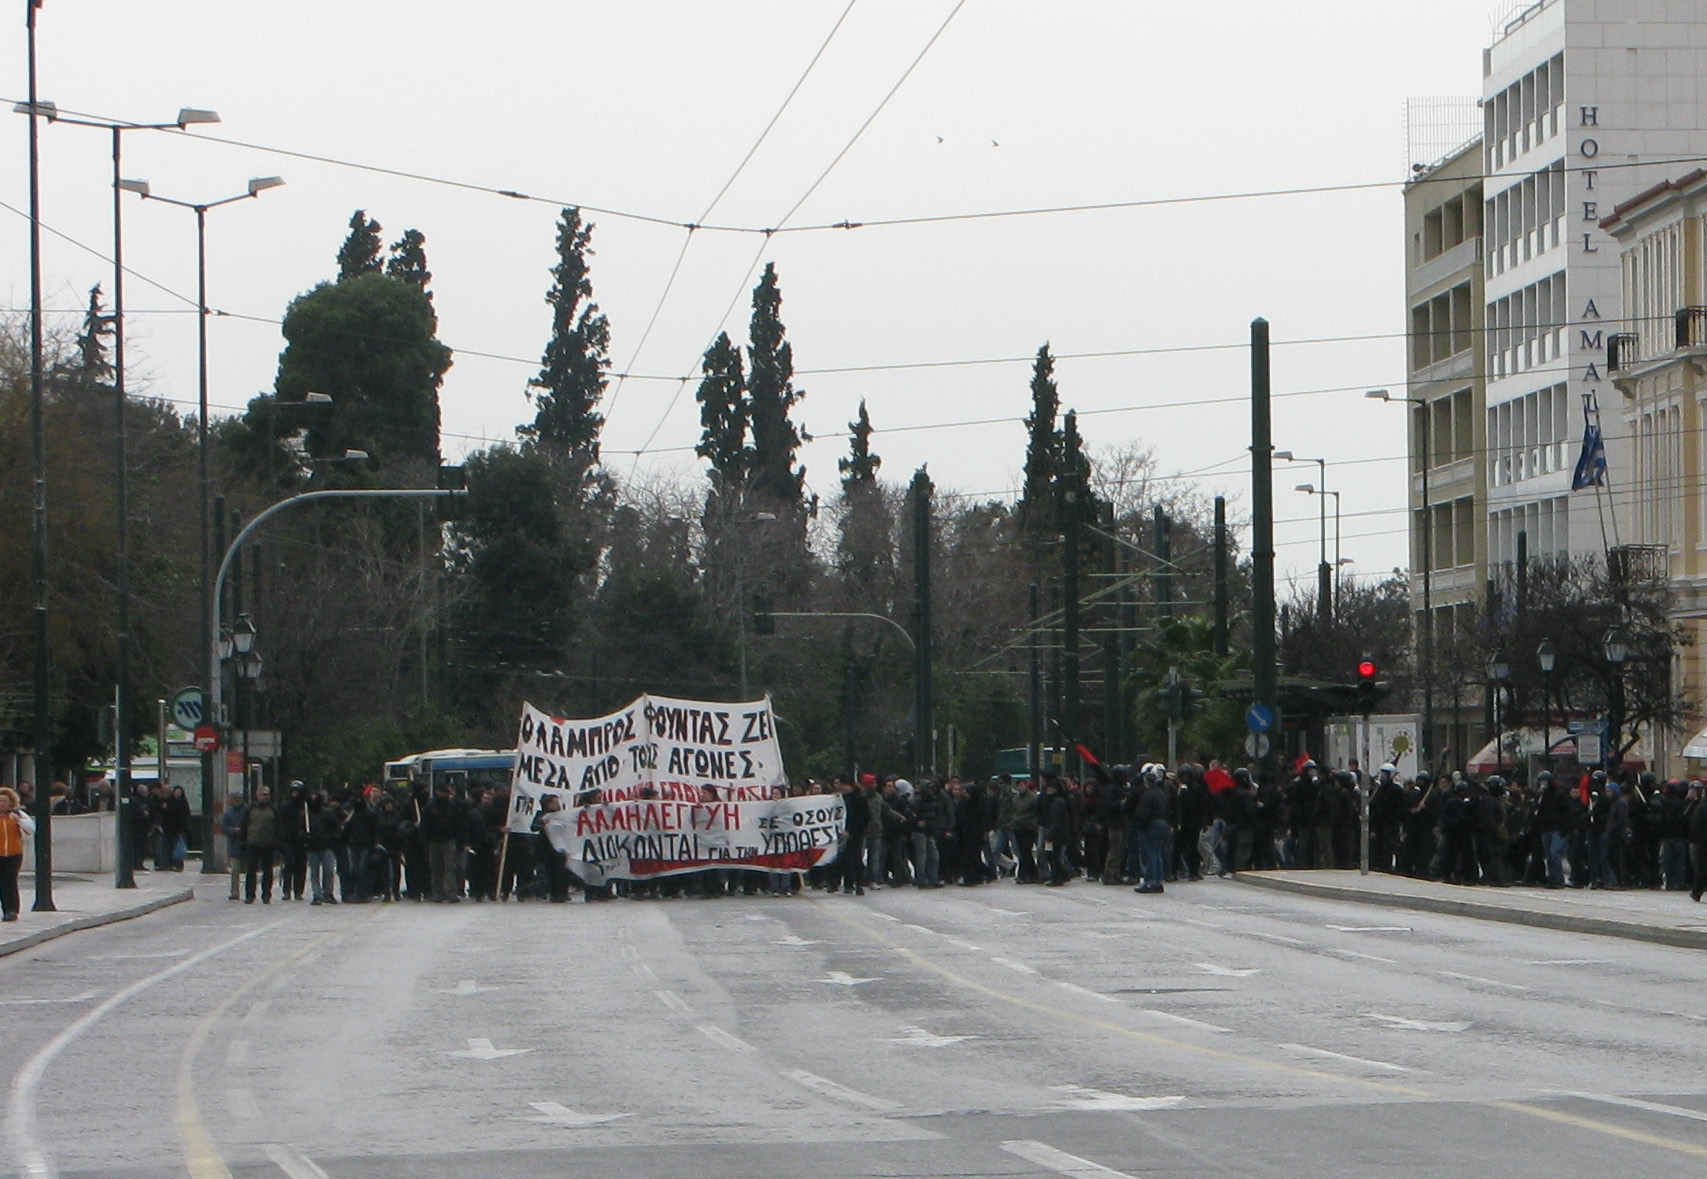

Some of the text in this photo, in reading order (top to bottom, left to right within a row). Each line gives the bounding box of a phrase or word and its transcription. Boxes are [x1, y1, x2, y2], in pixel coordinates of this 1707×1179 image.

[1579, 106, 1600, 253] HOTEL
[643, 700, 733, 746] ΦΟΥΝΤΑΣ
[740, 709, 773, 744] ΖΕΙ
[579, 754, 620, 791] ΑΠΟ
[757, 815, 780, 830] ΣΕ
[791, 805, 845, 827] ΟΣΟΥΣ
[708, 846, 732, 861] ΓΙΑ
